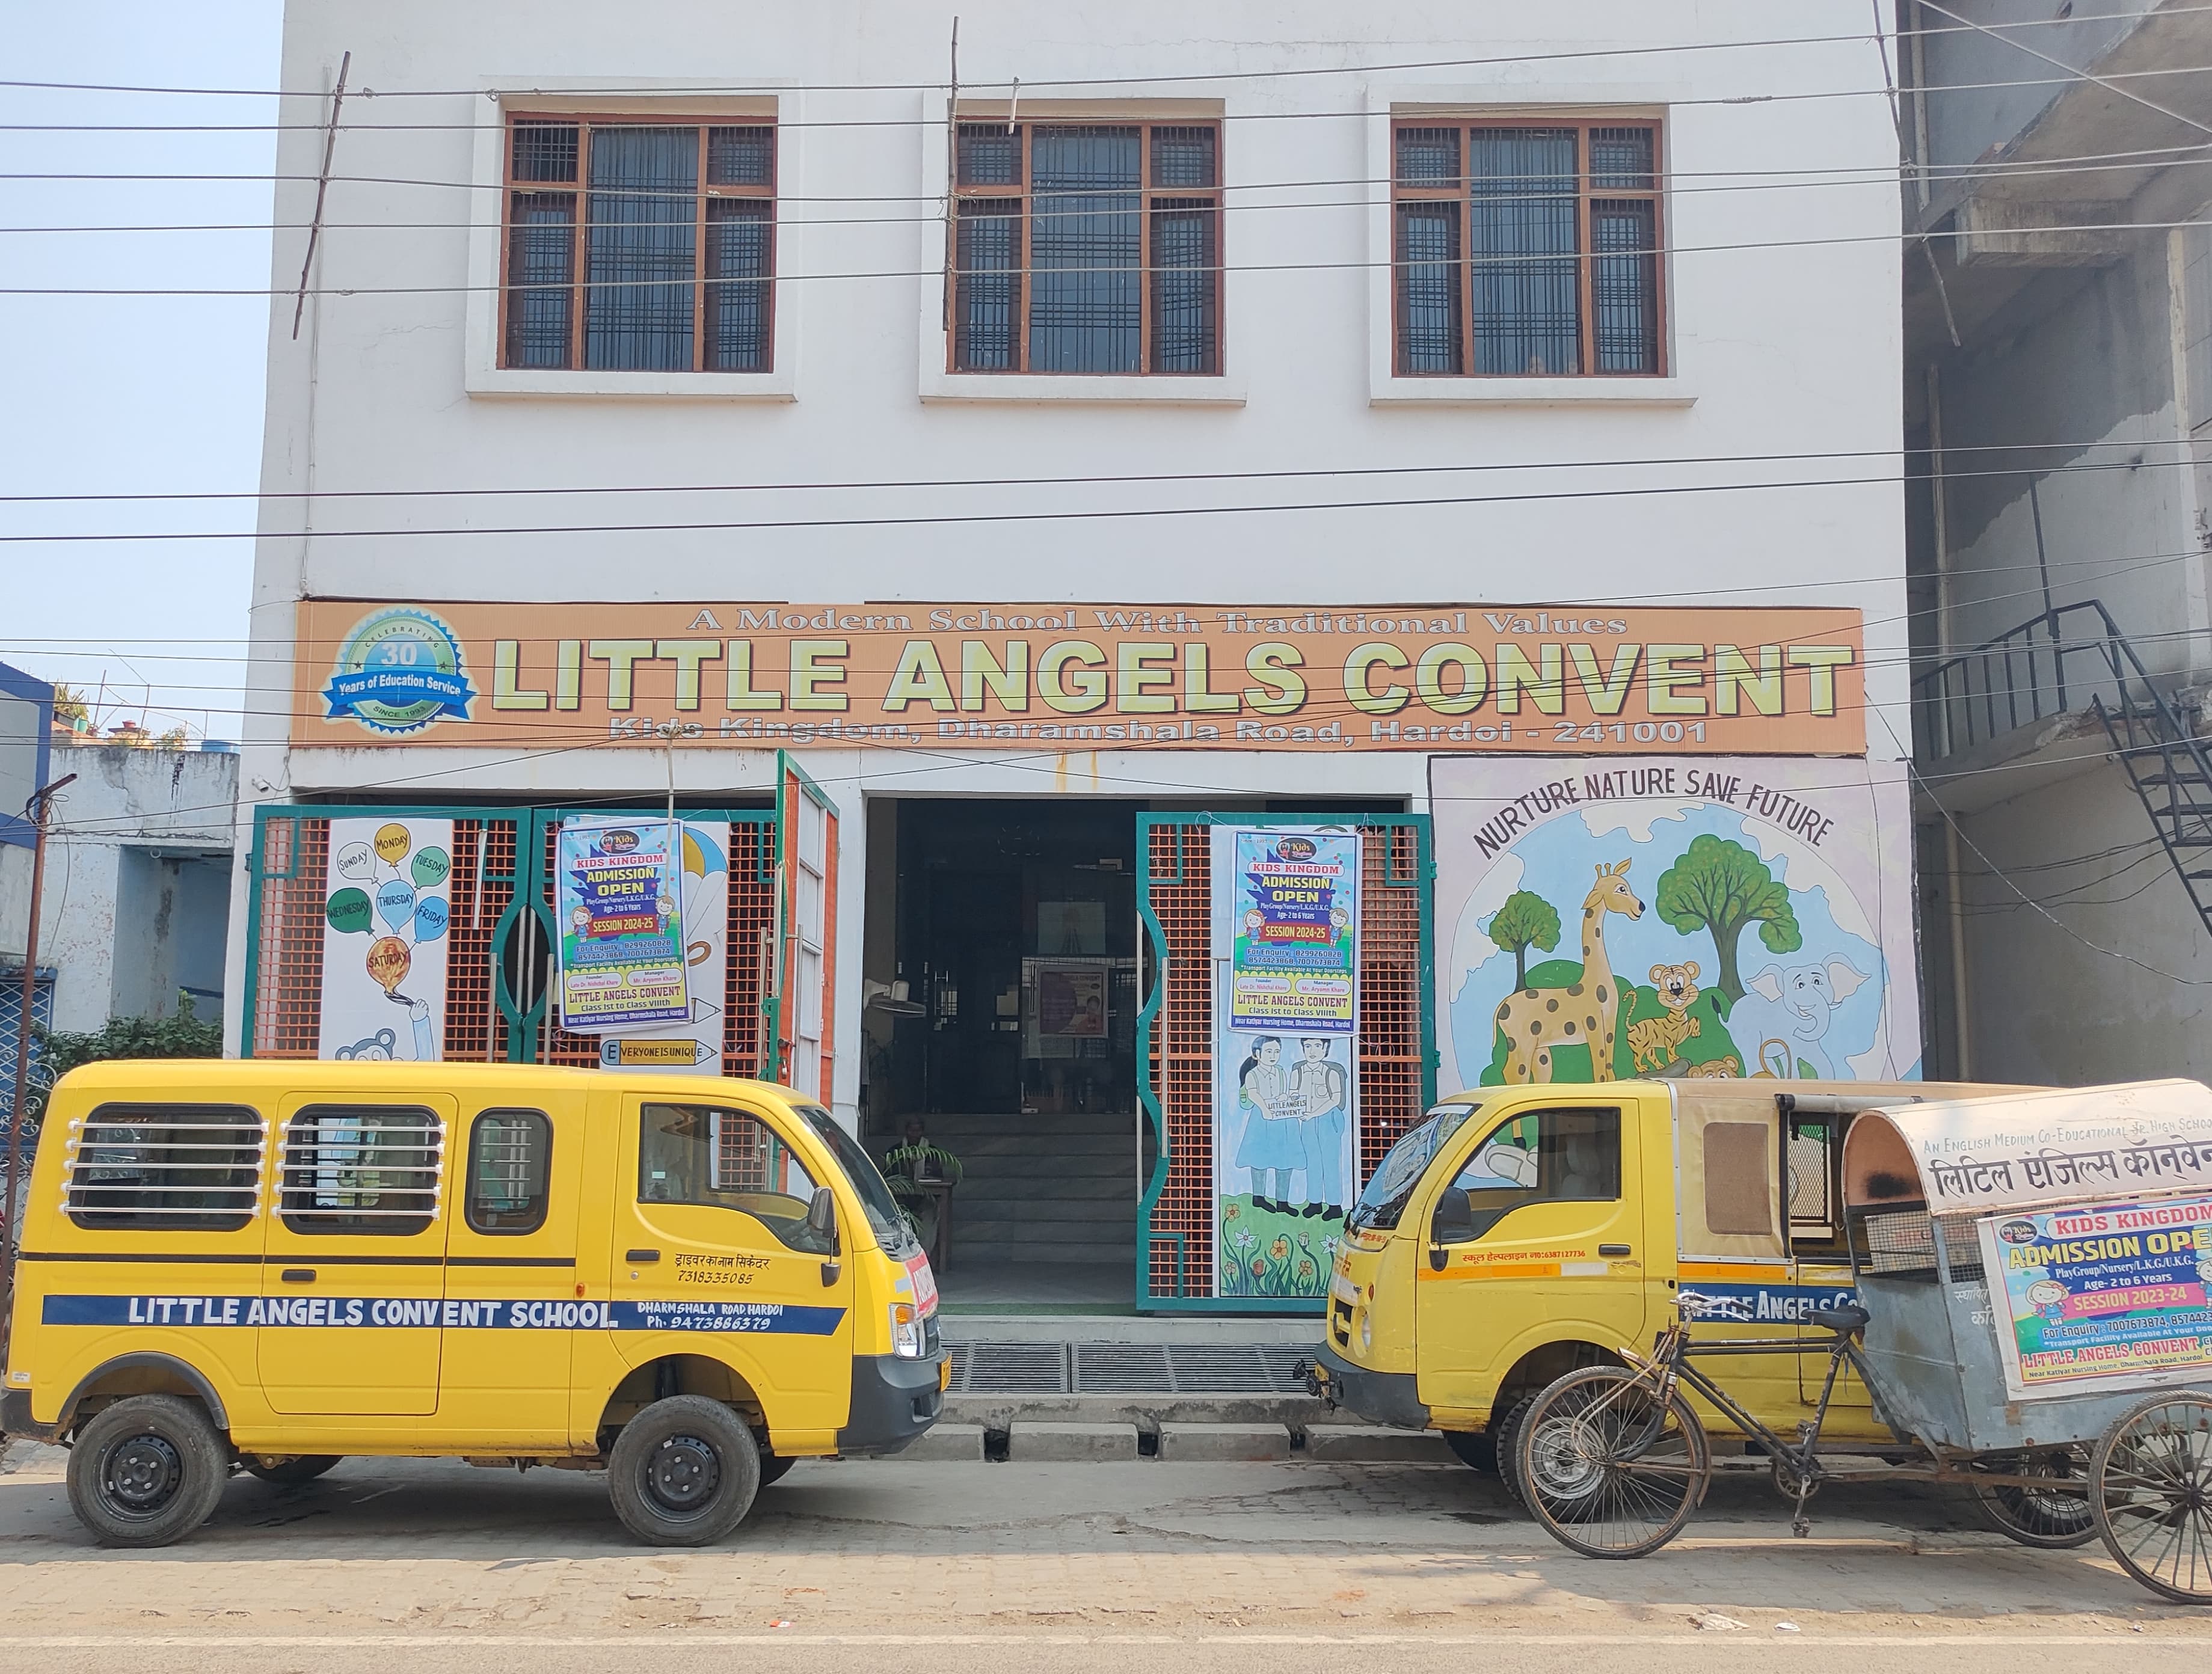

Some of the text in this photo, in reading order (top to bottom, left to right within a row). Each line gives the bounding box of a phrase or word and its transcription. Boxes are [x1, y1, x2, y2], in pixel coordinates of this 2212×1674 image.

[687, 609, 1627, 634] A Modern School With Traditional Values
[366, 627, 439, 648] CELEBRATING
[381, 642, 417, 666] 30
[339, 675, 461, 696] Years of Education Service
[492, 639, 1854, 716] LITTLE ANGELS CONVENT
[373, 706, 400, 717] SINCE
[610, 718, 704, 739] Kids
[720, 718, 921, 744] Kingdom,
[939, 718, 1229, 741] Dharamshala
[1236, 722, 1355, 747] Road,
[1371, 722, 1511, 743] Hardoi
[1553, 722, 1706, 743] 241001
[1473, 768, 1834, 860] NURTURE NATURE SAVE FUTURE
[376, 834, 408, 851] MONDAY
[1291, 843, 1310, 852] Kids
[339, 850, 368, 871] SUNDAY
[415, 854, 448, 877] TUESDAY
[577, 854, 663, 868] KIDS KINGDOM
[1253, 863, 1339, 874] KIDS KINGDOM
[586, 867, 655, 883] ADMISSION
[1262, 876, 1330, 889] ADMISSION
[598, 881, 644, 897] OPEN
[1272, 891, 1319, 903] OPEN
[327, 900, 370, 919] WEDNESDAY
[377, 893, 415, 909] THURSDAY
[417, 906, 447, 928] FRIDAY
[593, 917, 653, 932] SESSION 2024-25
[1265, 925, 1326, 938] SESSION 2024-25
[590, 943, 618, 952] Enquiry
[624, 939, 671, 949] 8299260828
[627, 949, 671, 958] 7007673874
[368, 951, 410, 969] SATURDAY
[570, 986, 681, 1004] LITTLE ANGELS CONVENT
[1238, 995, 1348, 1008] LITTLE ANGELS CONVENT
[582, 1003, 601, 1011] Class
[627, 1000, 647, 1009] Class
[1924, 1140, 1940, 1154] AN
[1944, 1138, 1991, 1152] ENGLISH
[1994, 1133, 2035, 1147] MEDIUM
[2038, 1127, 2128, 1144] CO-EDUCATIONAL
[2151, 1120, 2175, 1132] HIGH
[1928, 1155, 2014, 1198] लिटिल
[2017, 1147, 2119, 1188] एंजिल्स
[2056, 1216, 2108, 1234] KIDS
[2009, 1228, 2212, 1269] ADMISSION OPE
[706, 1256, 718, 1266] का
[718, 1257, 734, 1268] नाम
[1462, 1254, 1484, 1265] स्कूल
[1486, 1252, 1527, 1262] हेल्पलाइन
[678, 1269, 755, 1284] 7318335085
[2085, 1273, 2172, 1290] Age- 2 to 6 Years
[2074, 1286, 2187, 1311] SESSION 2023-24
[129, 1298, 619, 1328] LITTLE ANGELS CONVENT SCHOOL
[637, 1302, 716, 1315] DHARMSHALA
[647, 1316, 770, 1330] Ph. 9473886379
[2044, 1328, 2060, 1339] For
[2062, 1323, 2099, 1338] Enquiry
[2107, 1316, 2169, 1332] 7007673874,
[2091, 1333, 2120, 1344] Facility
[2122, 1329, 2160, 1341] Available
[2023, 1351, 2074, 1369] LITTLE
[2078, 1344, 2130, 1363] ANGELS
[2133, 1337, 2199, 1357] CONVENT
[2029, 1370, 2044, 1378] Near
[2072, 1364, 2098, 1375] Nursing
[2121, 1358, 2158, 1369] Dharmshala
